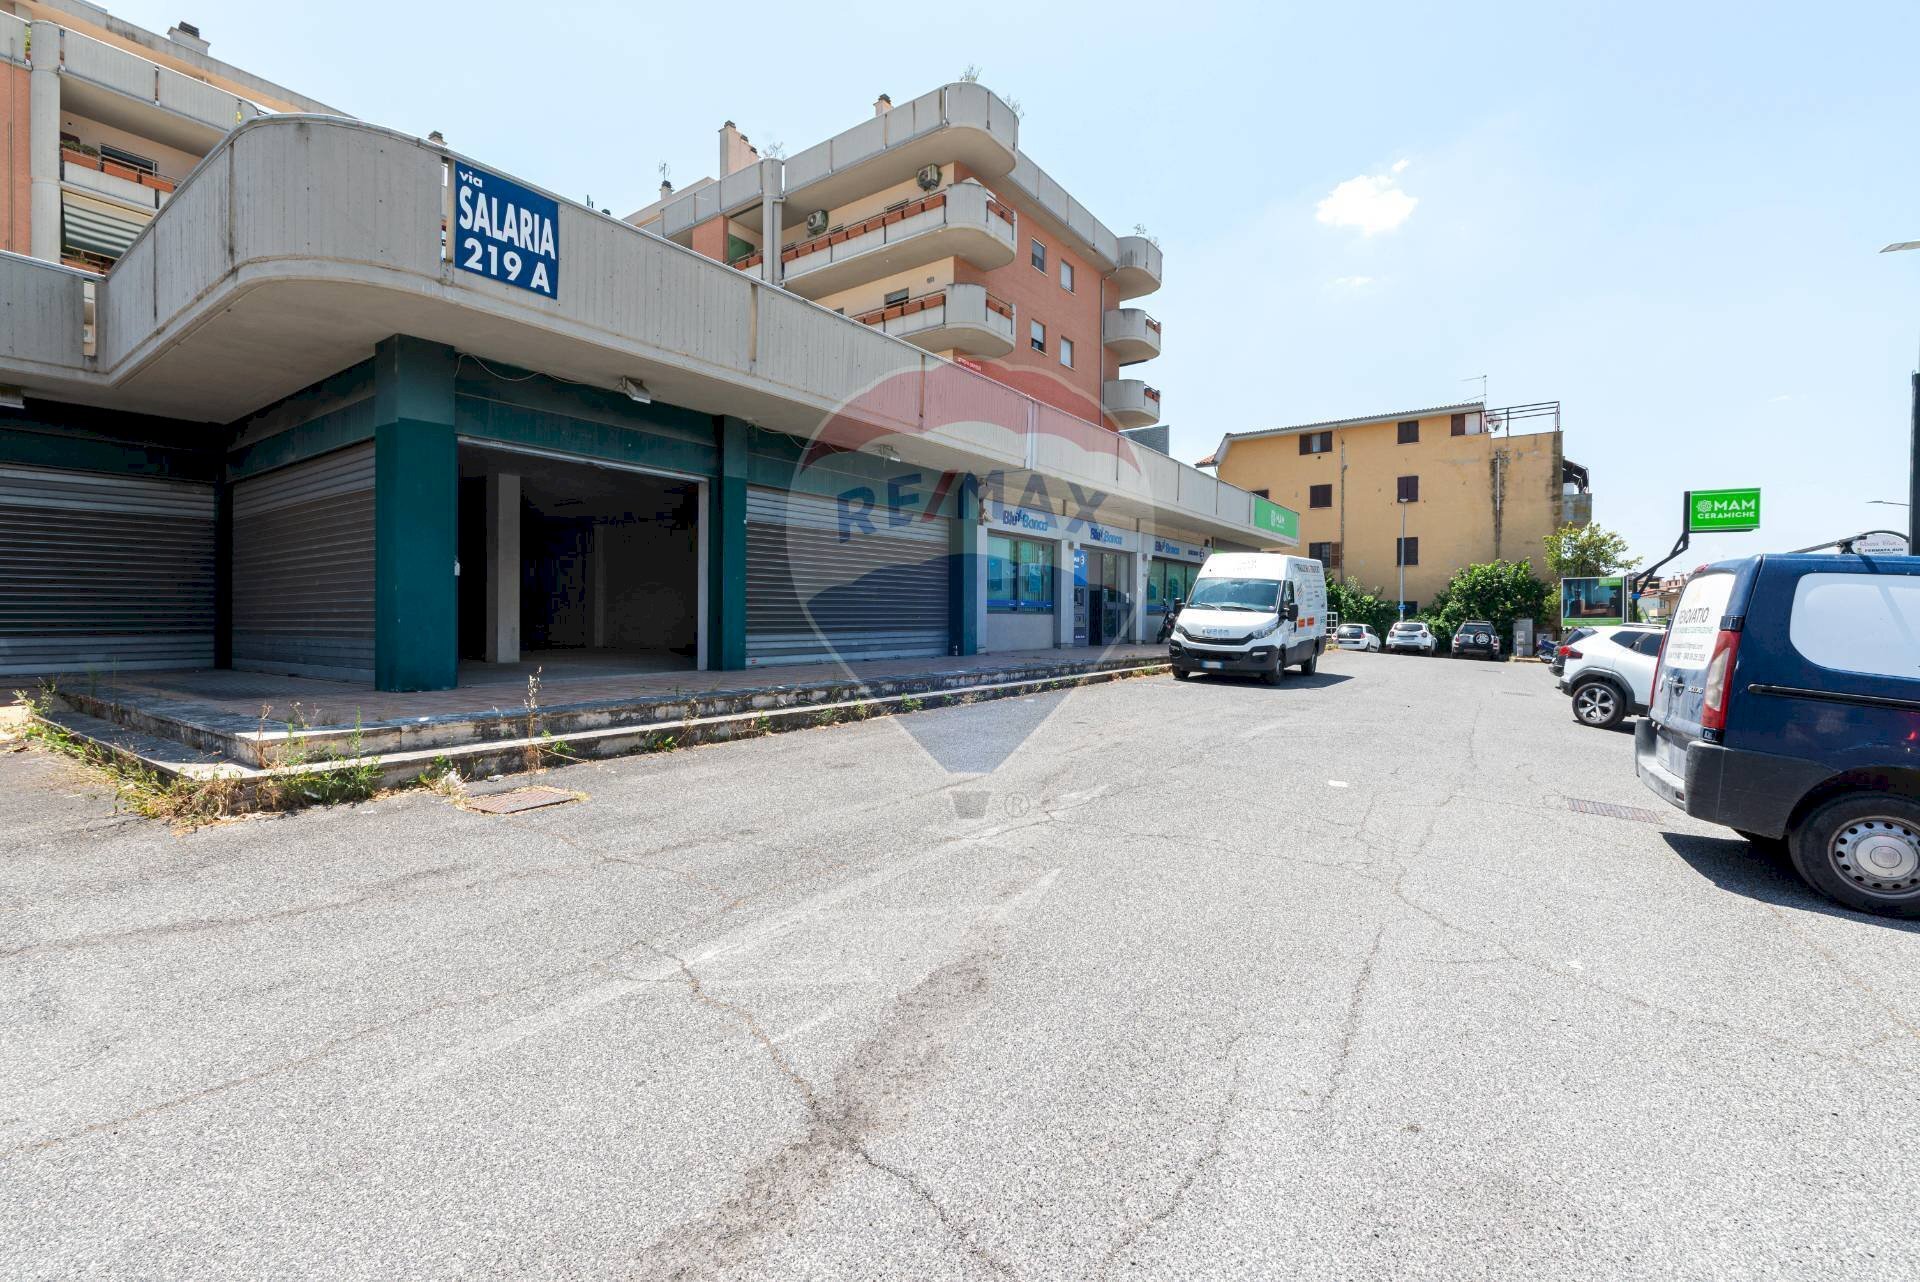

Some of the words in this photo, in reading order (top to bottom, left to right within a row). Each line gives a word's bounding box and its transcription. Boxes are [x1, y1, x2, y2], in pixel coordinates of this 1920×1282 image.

[459, 171, 482, 187] via
[459, 186, 556, 260] SALARIA
[463, 237, 522, 281] 219
[530, 262, 550, 293] A
[1714, 499, 1755, 511] MAM
[1697, 511, 1755, 519] CERAMICHE
